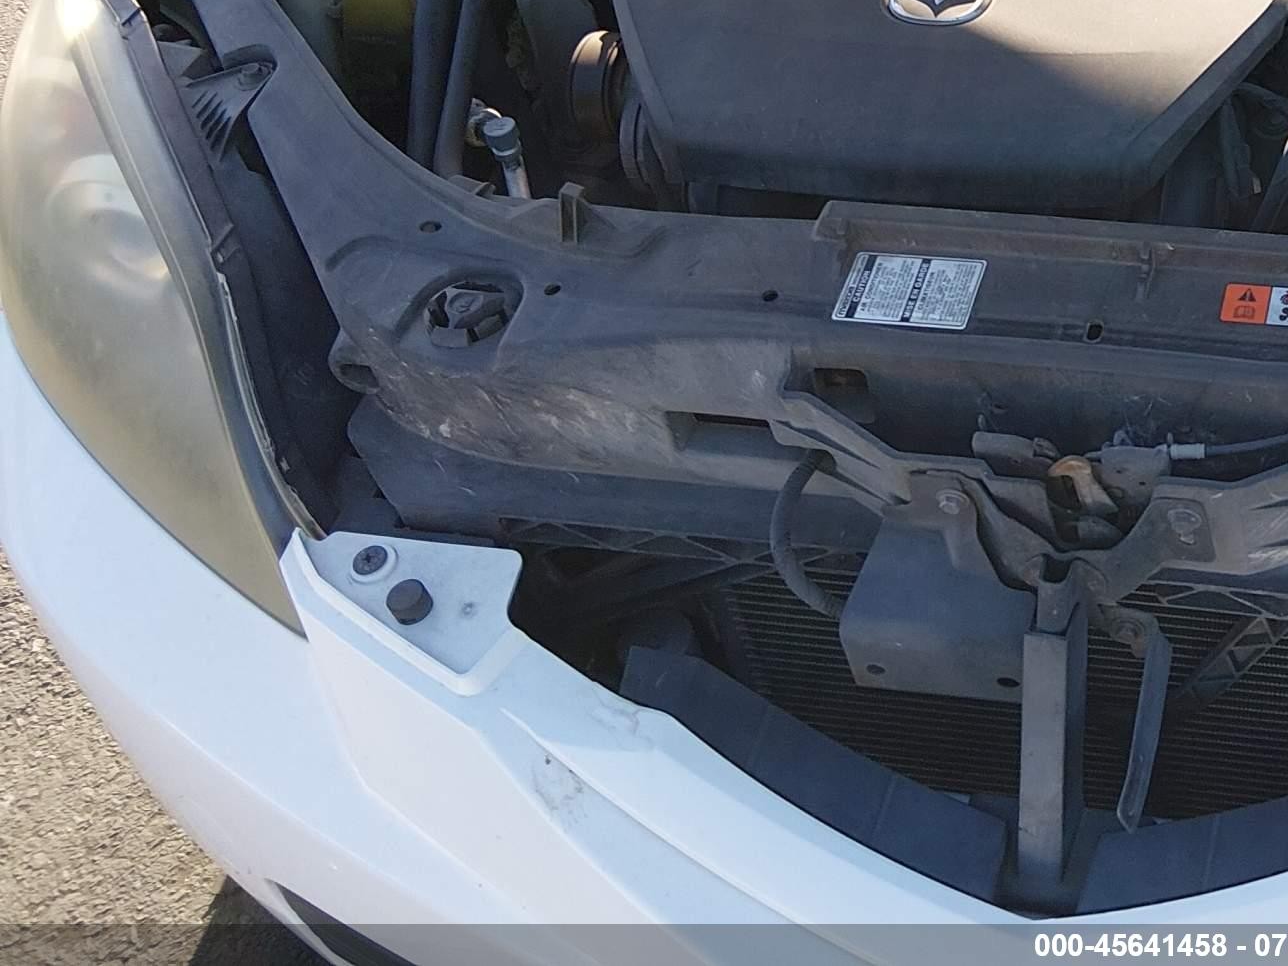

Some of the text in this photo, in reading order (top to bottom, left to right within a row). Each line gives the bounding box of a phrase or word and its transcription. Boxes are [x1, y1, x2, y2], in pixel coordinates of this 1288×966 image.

[852, 270, 871, 302] CAUTION
[903, 300, 915, 317] MISE
[915, 262, 929, 287] GARDE
